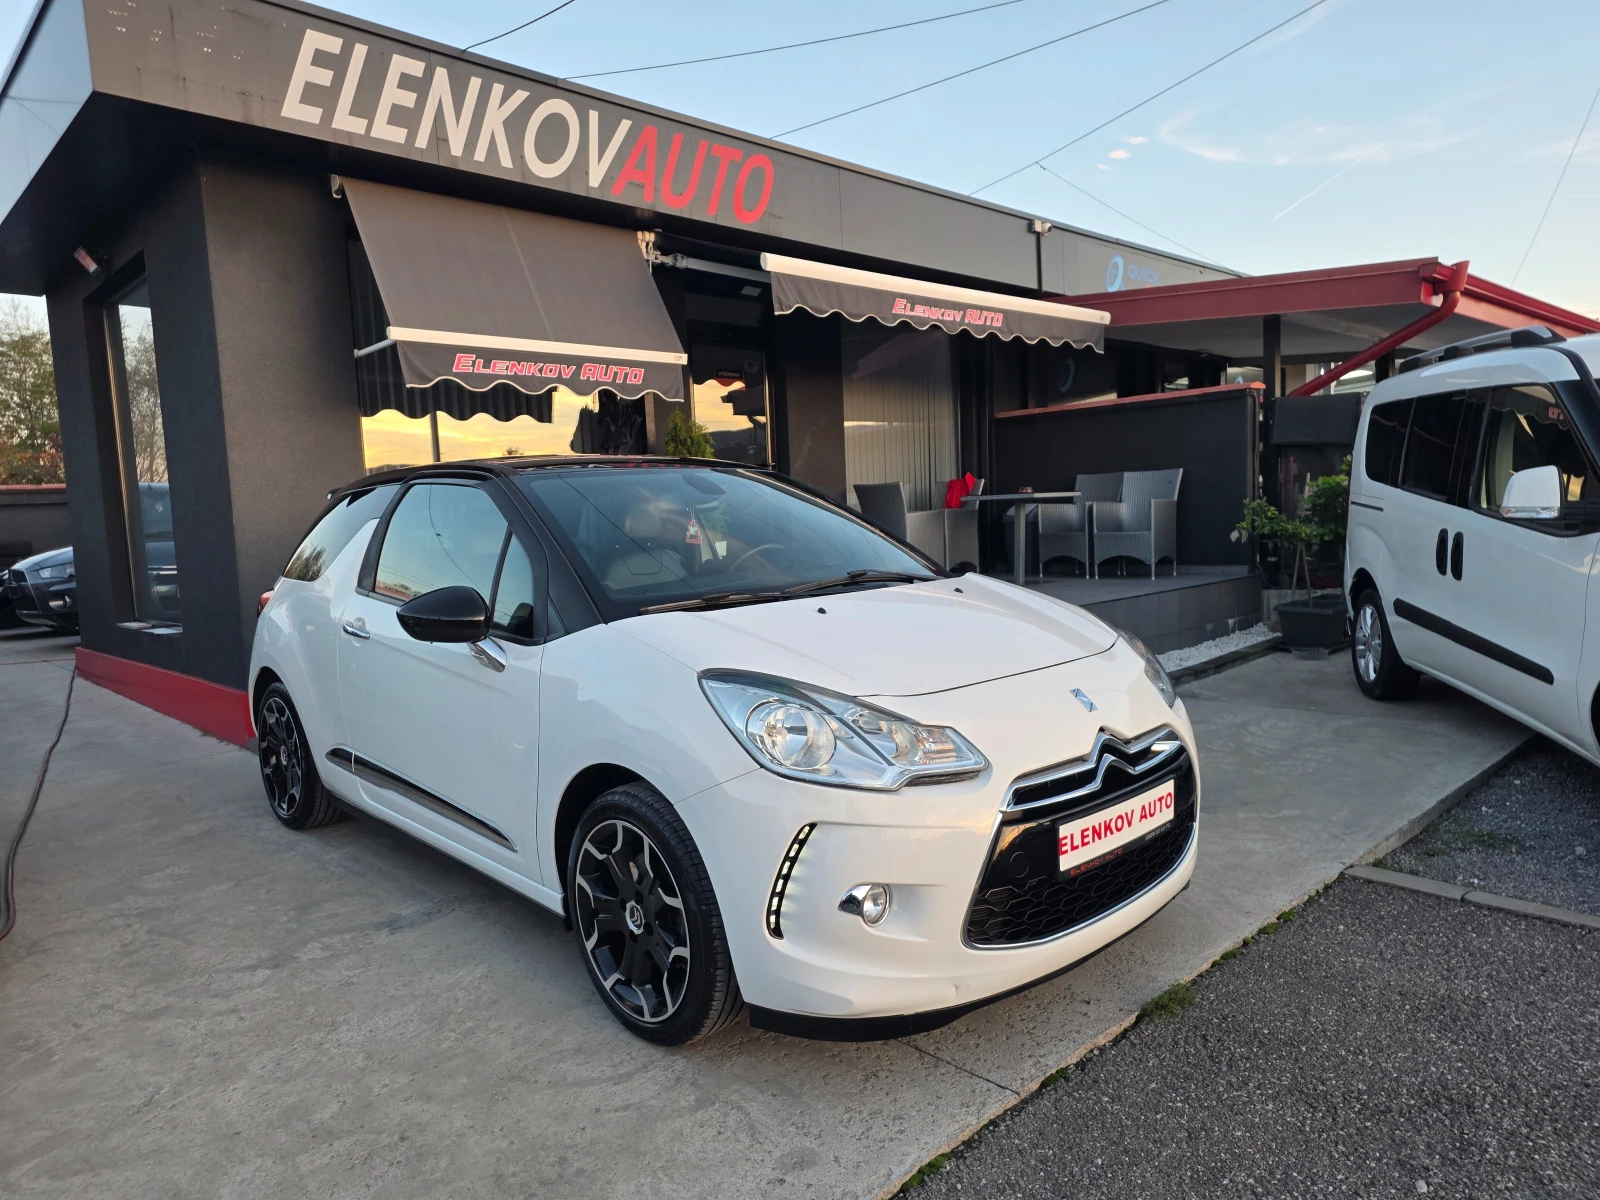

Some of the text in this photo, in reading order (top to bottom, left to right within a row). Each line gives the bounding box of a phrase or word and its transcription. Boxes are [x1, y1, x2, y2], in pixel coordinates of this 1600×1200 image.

[892, 297, 1004, 327] ELENKOV AUTO
[452, 353, 645, 385] ELENKOV AUTO
[1058, 808, 1135, 857] ELENKOV
[1138, 791, 1174, 823] AUTO
[1105, 847, 1123, 860] AUTO
